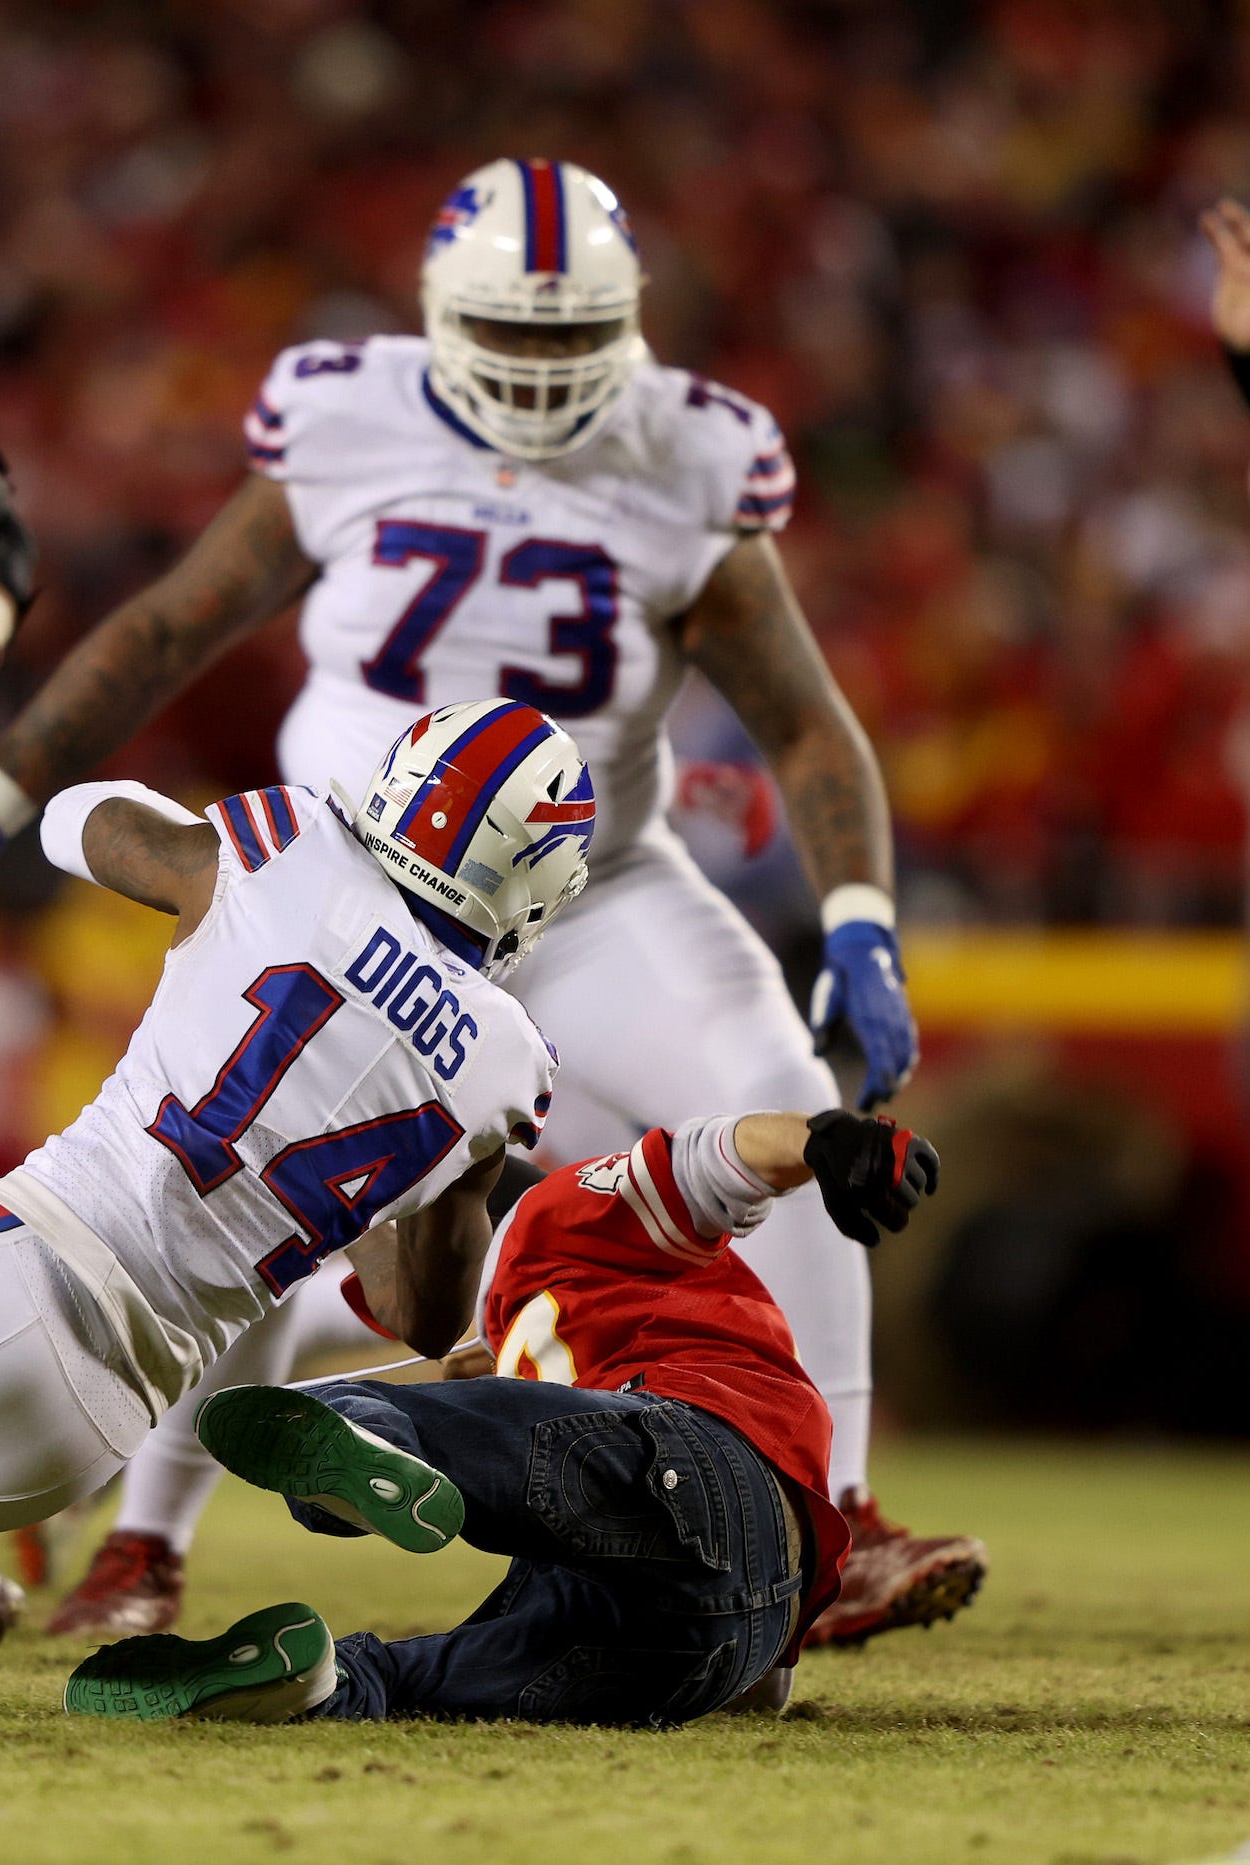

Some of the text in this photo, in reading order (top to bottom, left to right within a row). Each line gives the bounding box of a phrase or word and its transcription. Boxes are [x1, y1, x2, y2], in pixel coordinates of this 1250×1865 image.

[358, 519, 620, 719] 73
[365, 832, 467, 906] INSPIRE CHANGE
[344, 926, 478, 1081] DIGGS
[145, 962, 467, 1299] 14
